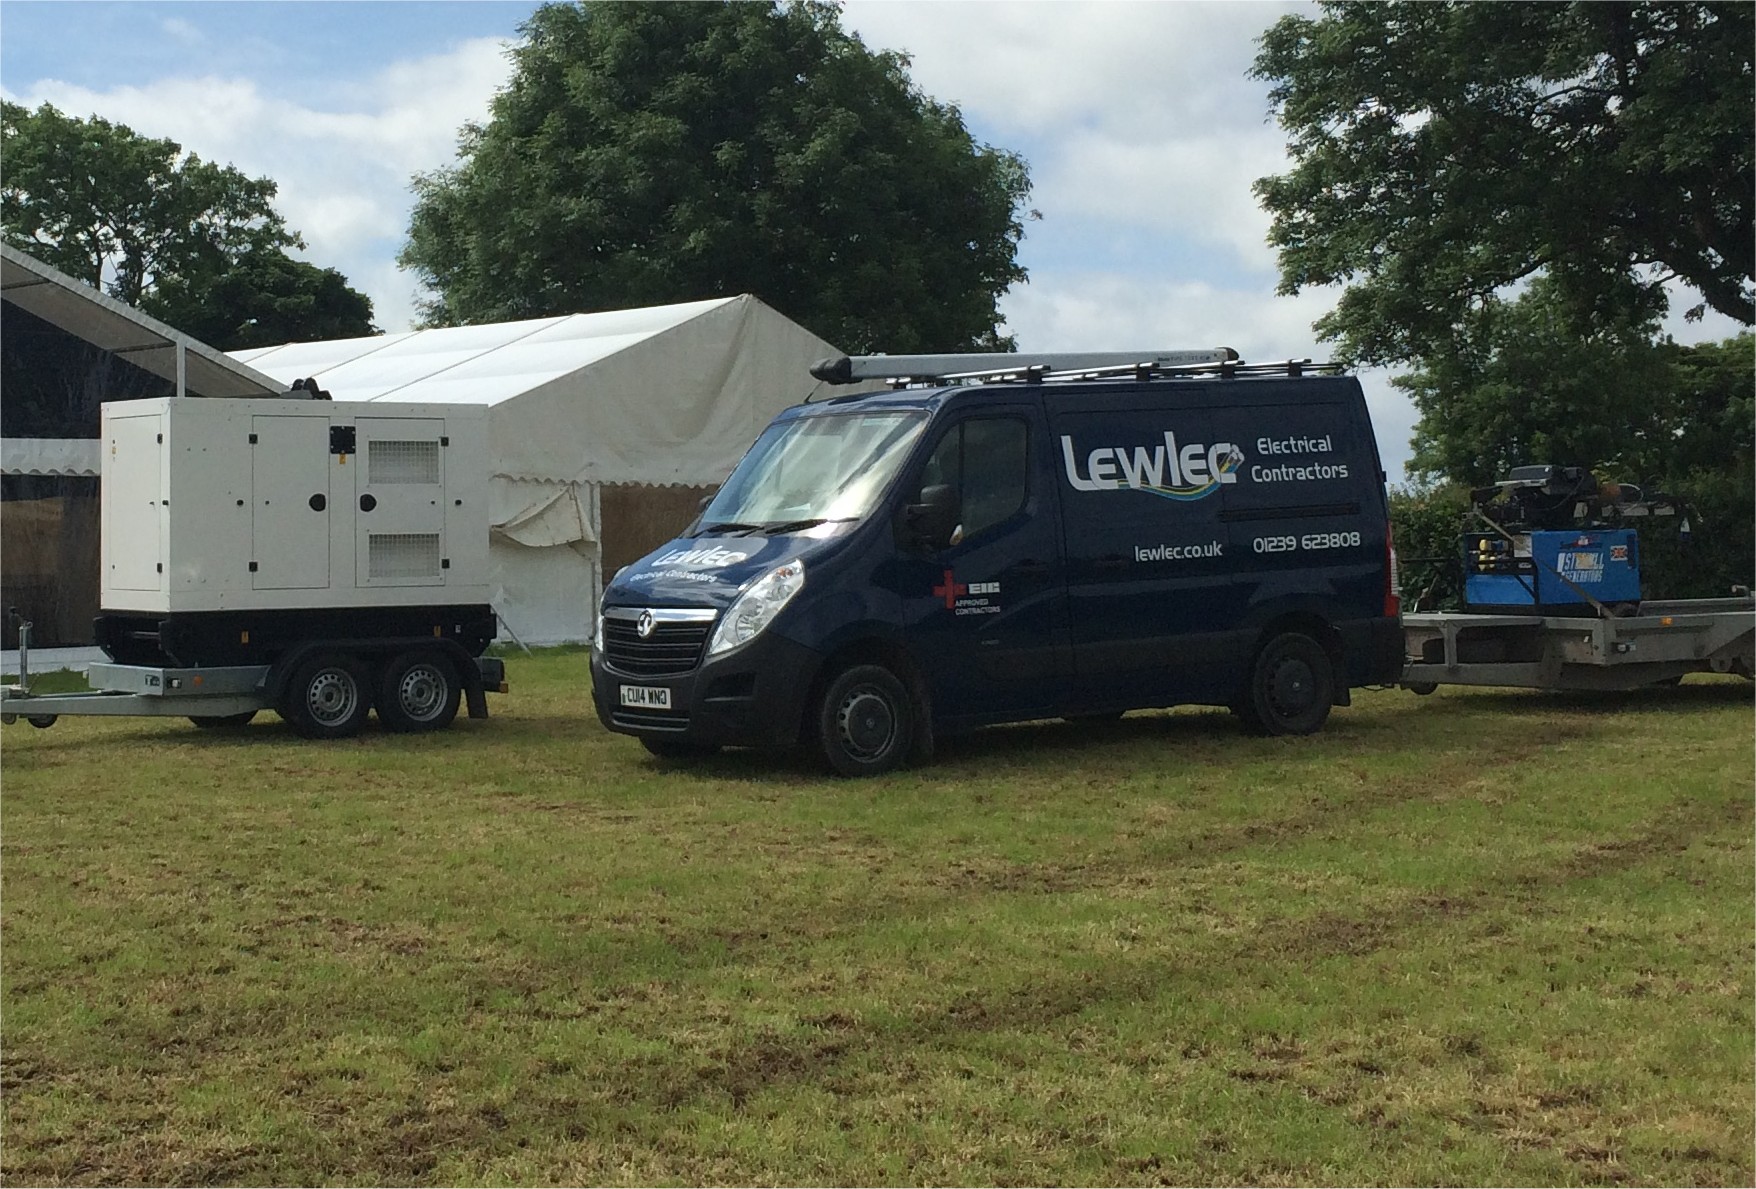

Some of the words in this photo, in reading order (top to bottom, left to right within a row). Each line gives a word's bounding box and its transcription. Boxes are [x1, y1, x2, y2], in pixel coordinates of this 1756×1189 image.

[1257, 434, 1333, 455] Electrical
[1251, 462, 1349, 483] Contractors
[1135, 540, 1223, 562] lewlec.co.uk
[1253, 535, 1297, 553] 01239
[1301, 531, 1361, 551] 623808
[969, 582, 1000, 594] EIC
[955, 606, 1000, 615] CONTRACTORS
[627, 687, 646, 704] CU14
